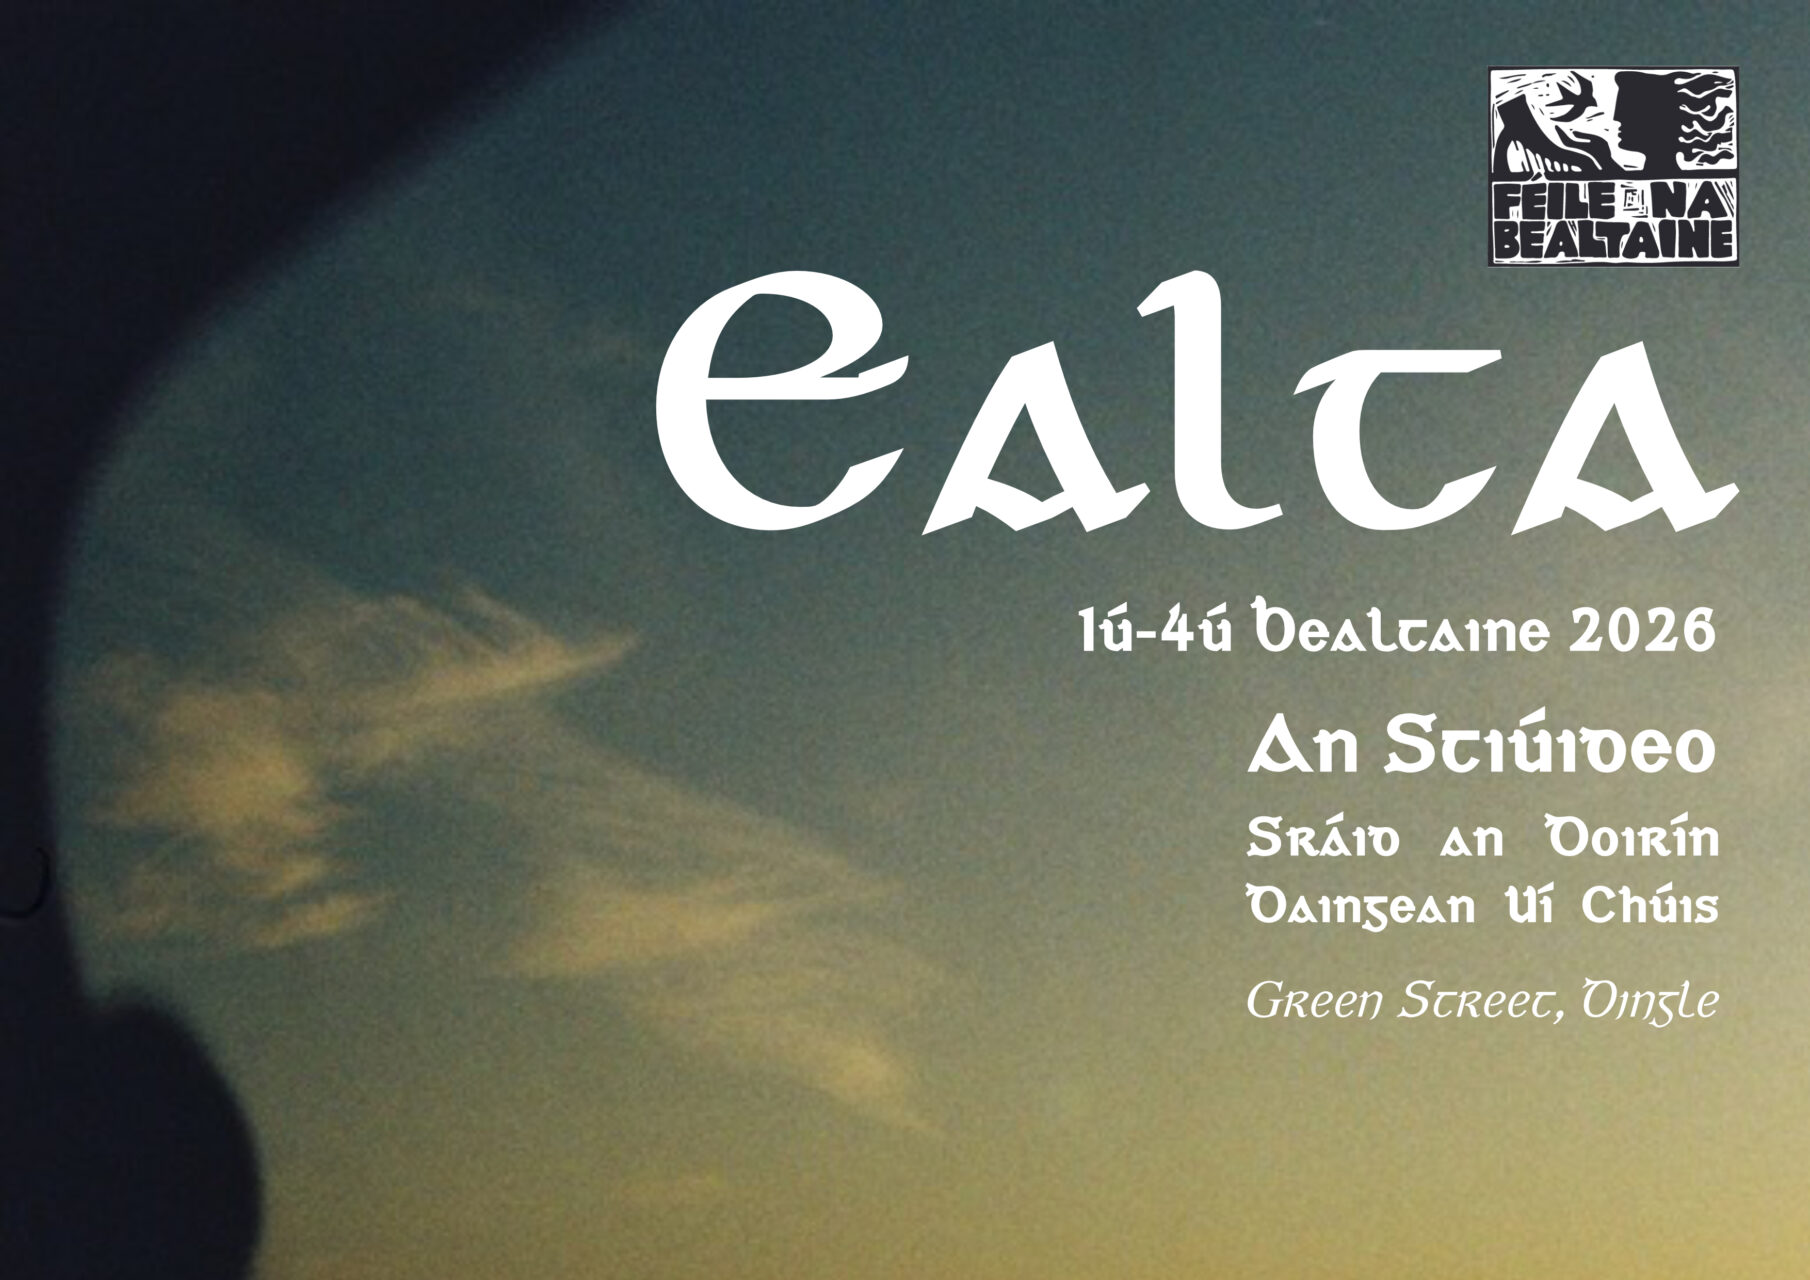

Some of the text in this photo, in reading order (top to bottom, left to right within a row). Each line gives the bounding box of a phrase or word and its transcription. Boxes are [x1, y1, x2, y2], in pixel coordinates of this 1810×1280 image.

[1493, 180, 1729, 220] FEILE NA
[1493, 219, 1733, 259] BEALTAINE
[655, 270, 1740, 536] Ealta
[1078, 595, 1716, 652] 1ú-4ú Bealtaine 2026
[1247, 706, 1716, 774] An Stiúideo
[1246, 811, 1719, 857] Sráid an Doirín
[1245, 881, 1719, 933] Daingean Uí Chúis
[1247, 977, 1720, 1028] Green Street, Dingle
